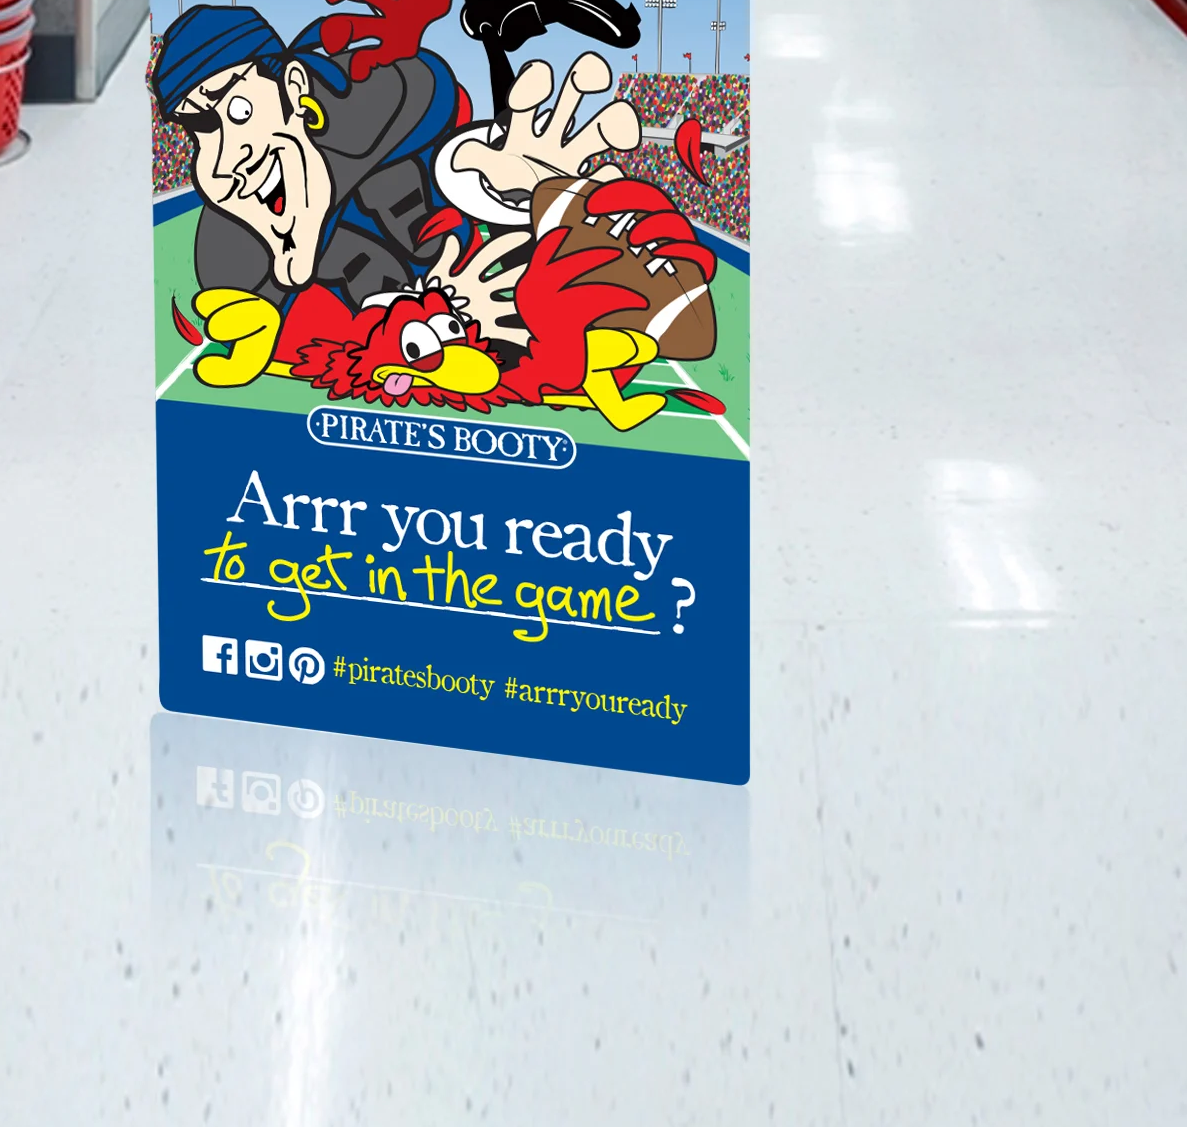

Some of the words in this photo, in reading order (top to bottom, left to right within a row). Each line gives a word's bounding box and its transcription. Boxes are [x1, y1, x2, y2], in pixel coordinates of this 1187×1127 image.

[321, 413, 444, 451] PIRATE'S
[454, 427, 563, 462] BOOTY
[226, 470, 368, 537] Arrr
[382, 500, 488, 553] you
[505, 510, 673, 581] ready
[203, 530, 248, 582] to
[267, 543, 353, 622] get
[367, 554, 408, 603] in
[412, 550, 503, 608] the
[513, 577, 656, 642] game
[333, 654, 495, 700] #piratesbooty
[505, 679, 688, 725] #arrryouready
